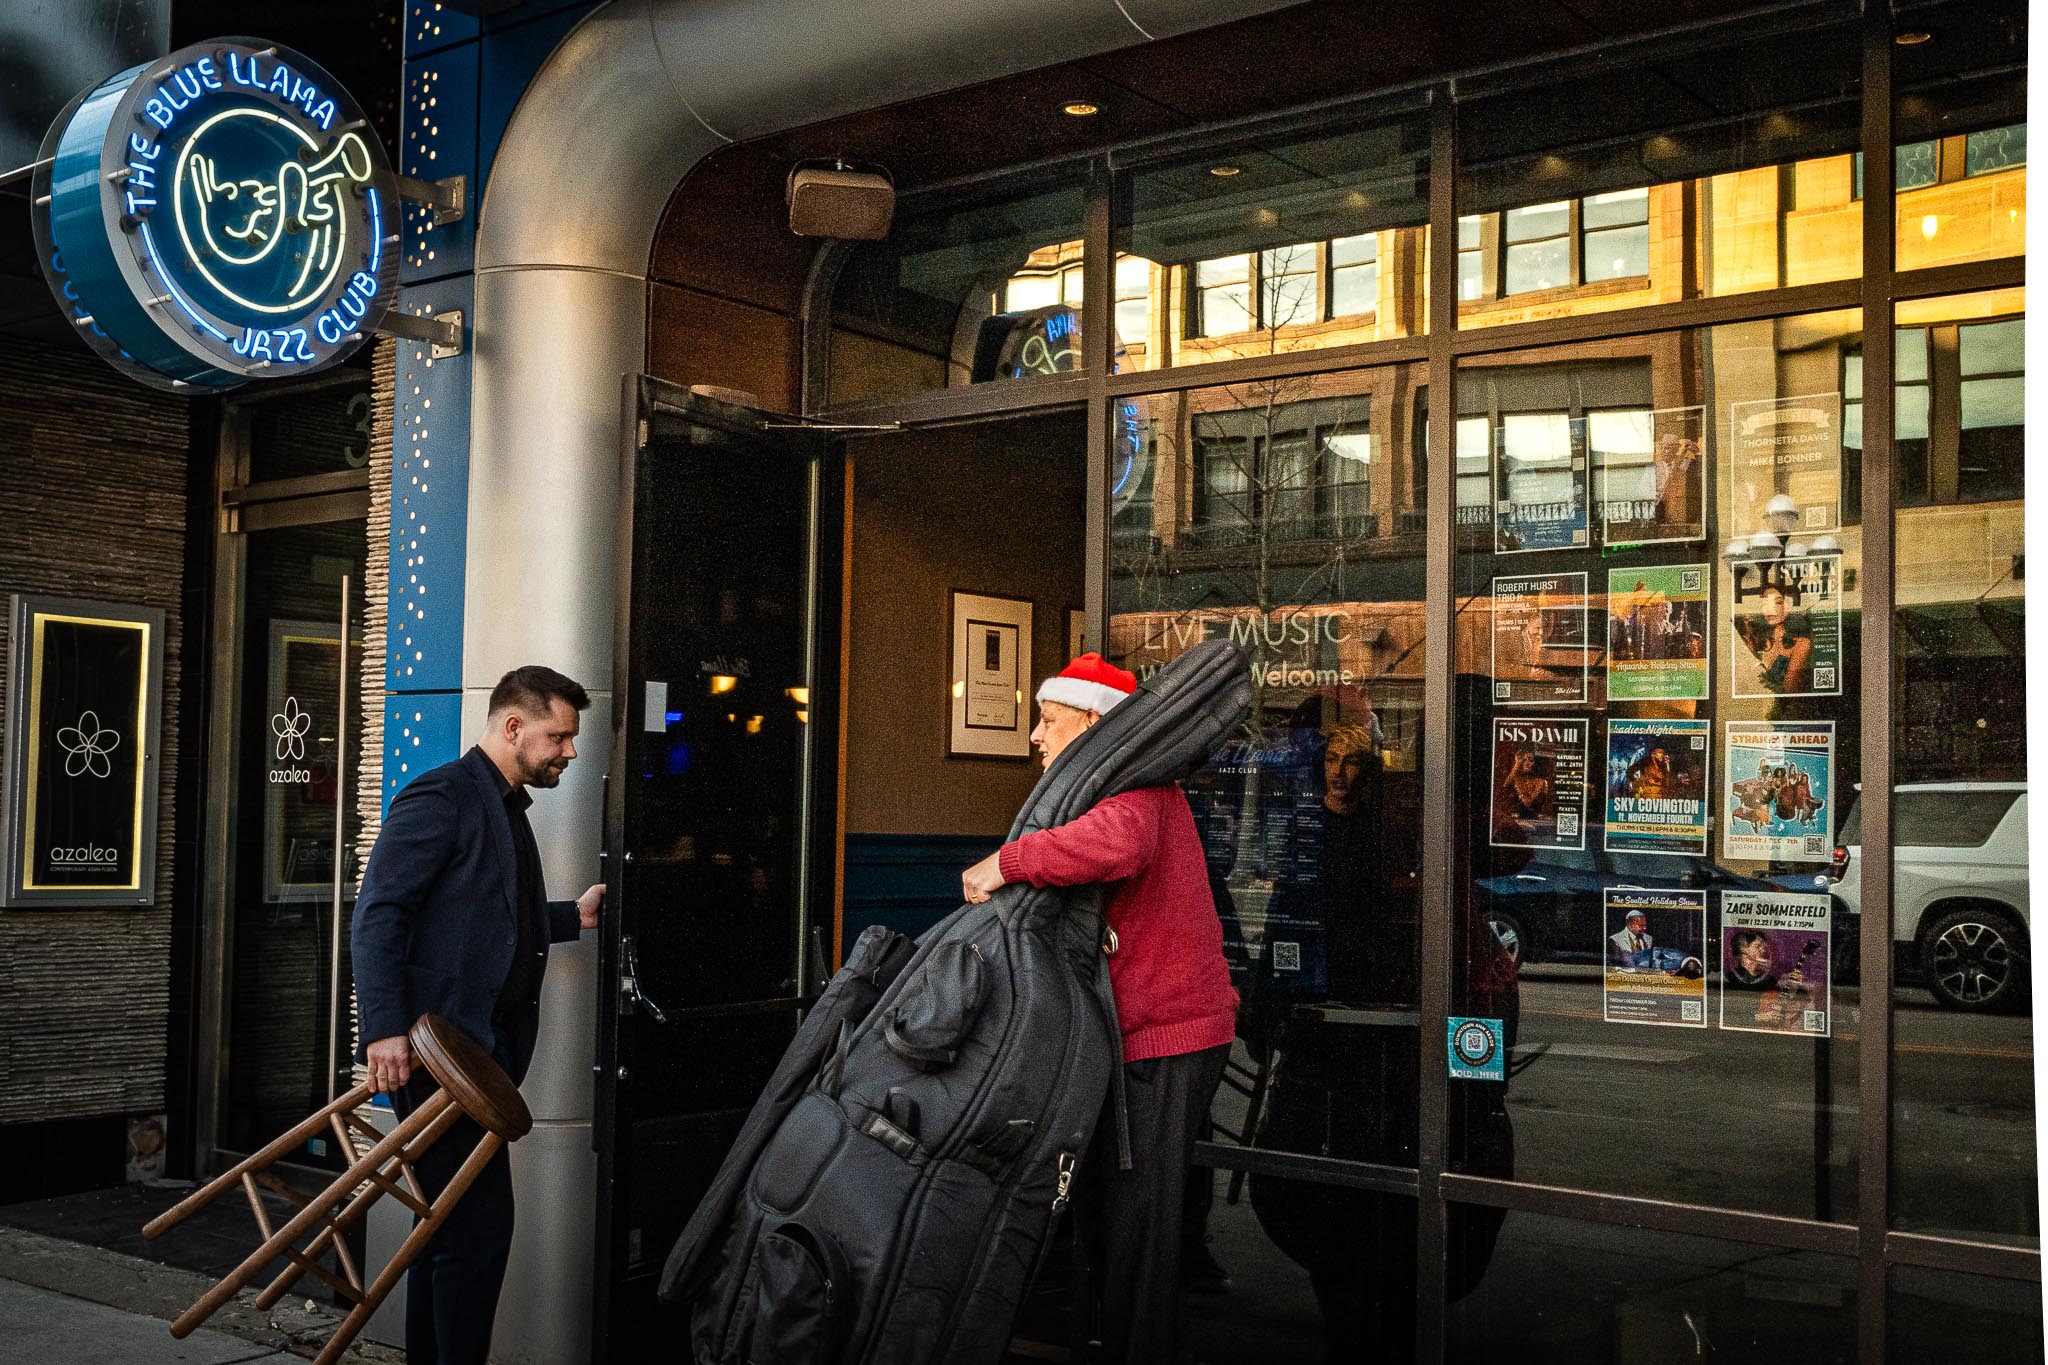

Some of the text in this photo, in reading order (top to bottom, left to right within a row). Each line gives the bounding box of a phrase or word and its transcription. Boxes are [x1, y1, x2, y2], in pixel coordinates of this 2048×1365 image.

[127, 52, 336, 215] THE BLUE LLAMA
[232, 272, 377, 362] JAZZ CLUB
[1743, 432, 1829, 448] THORNETTA DAVIS
[1749, 452, 1822, 466] MIKE BONNER
[1497, 580, 1558, 593] ROBERT HURST
[1497, 593, 1515, 602] TRIO
[1144, 610, 1351, 649] LIVE MUSIC
[1251, 659, 1354, 687] Welcome
[1650, 661, 1678, 671] Holiday
[1499, 727, 1527, 742] ISIS
[1613, 723, 1673, 736] Ladies Night
[1790, 735, 1828, 745] AHEAD
[269, 764, 310, 783] azalea
[1238, 767, 1258, 775] CLUB
[1613, 797, 1699, 815] SKY COVINGTON
[1628, 813, 1665, 824] NOVEMBER
[1666, 814, 1693, 825] FOURTH
[50, 841, 118, 862] azalea
[1612, 895, 1698, 909] The Soulful Holiday Show
[1726, 902, 1826, 918] ZACH SOMMERFELD
[1454, 1022, 1495, 1047] DOWNTOWN ANN ARBOR
[1451, 1069, 1473, 1077] SOLD
